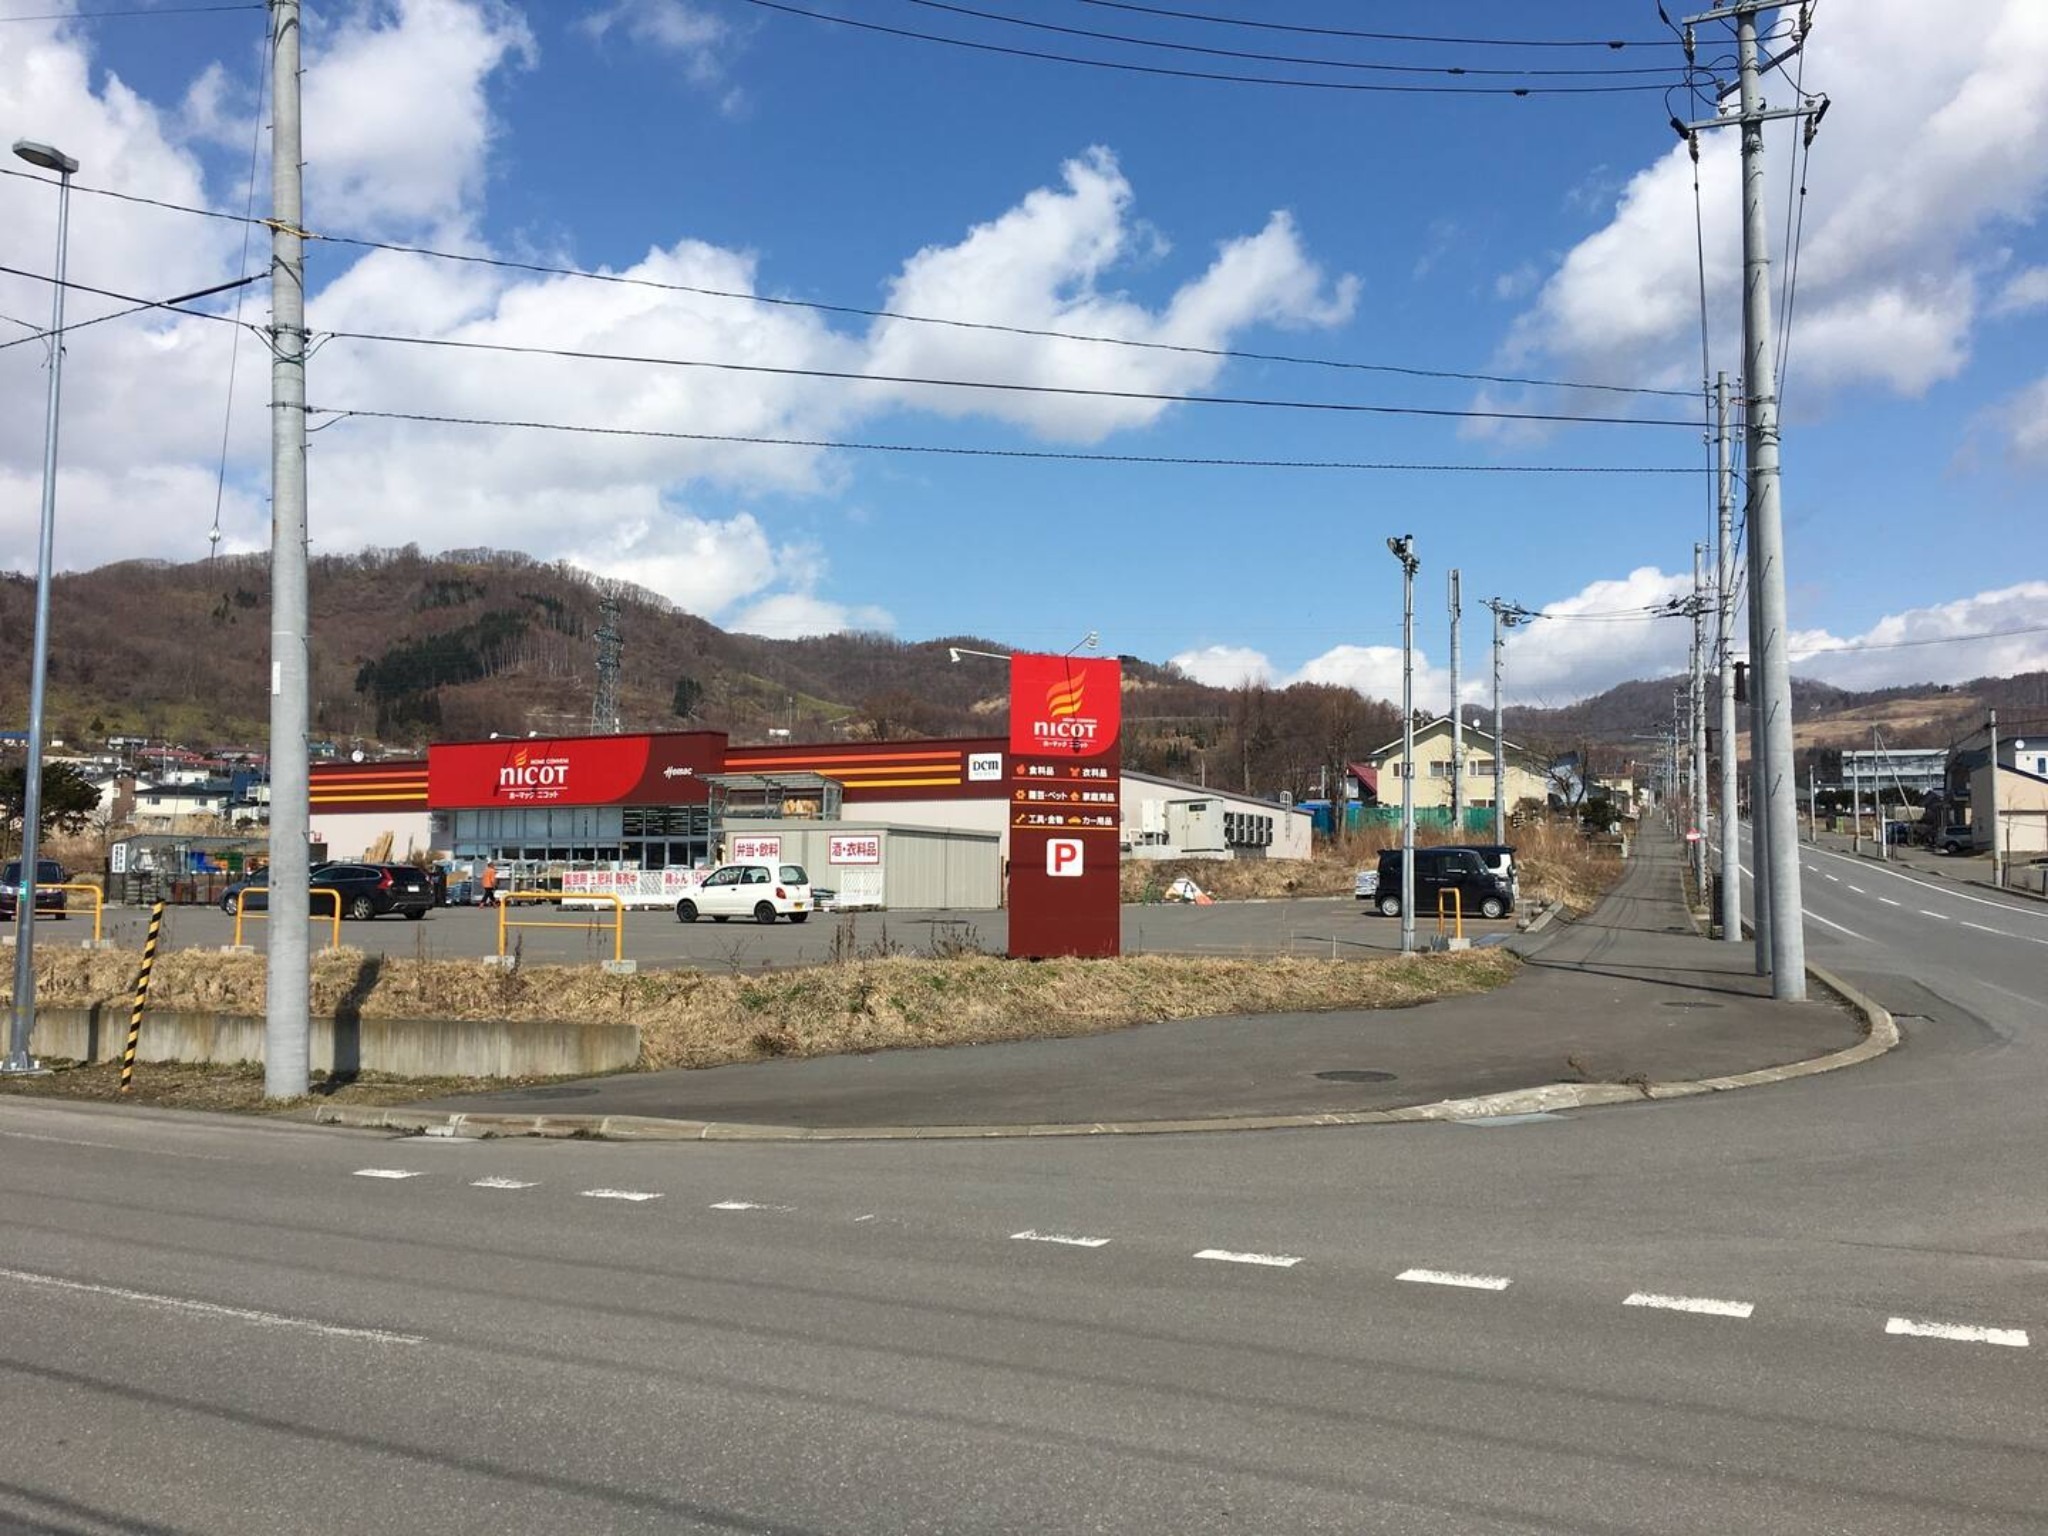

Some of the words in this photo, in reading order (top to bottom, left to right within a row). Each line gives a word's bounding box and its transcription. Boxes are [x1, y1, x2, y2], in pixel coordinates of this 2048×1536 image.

[1029, 765, 1054, 776] 食料品
[1082, 768, 1108, 778] 衣料品
[736, 842, 779, 857] 弁当・飲料
[832, 842, 877, 857] 酒・衣料品
[1055, 843, 1077, 873] P
